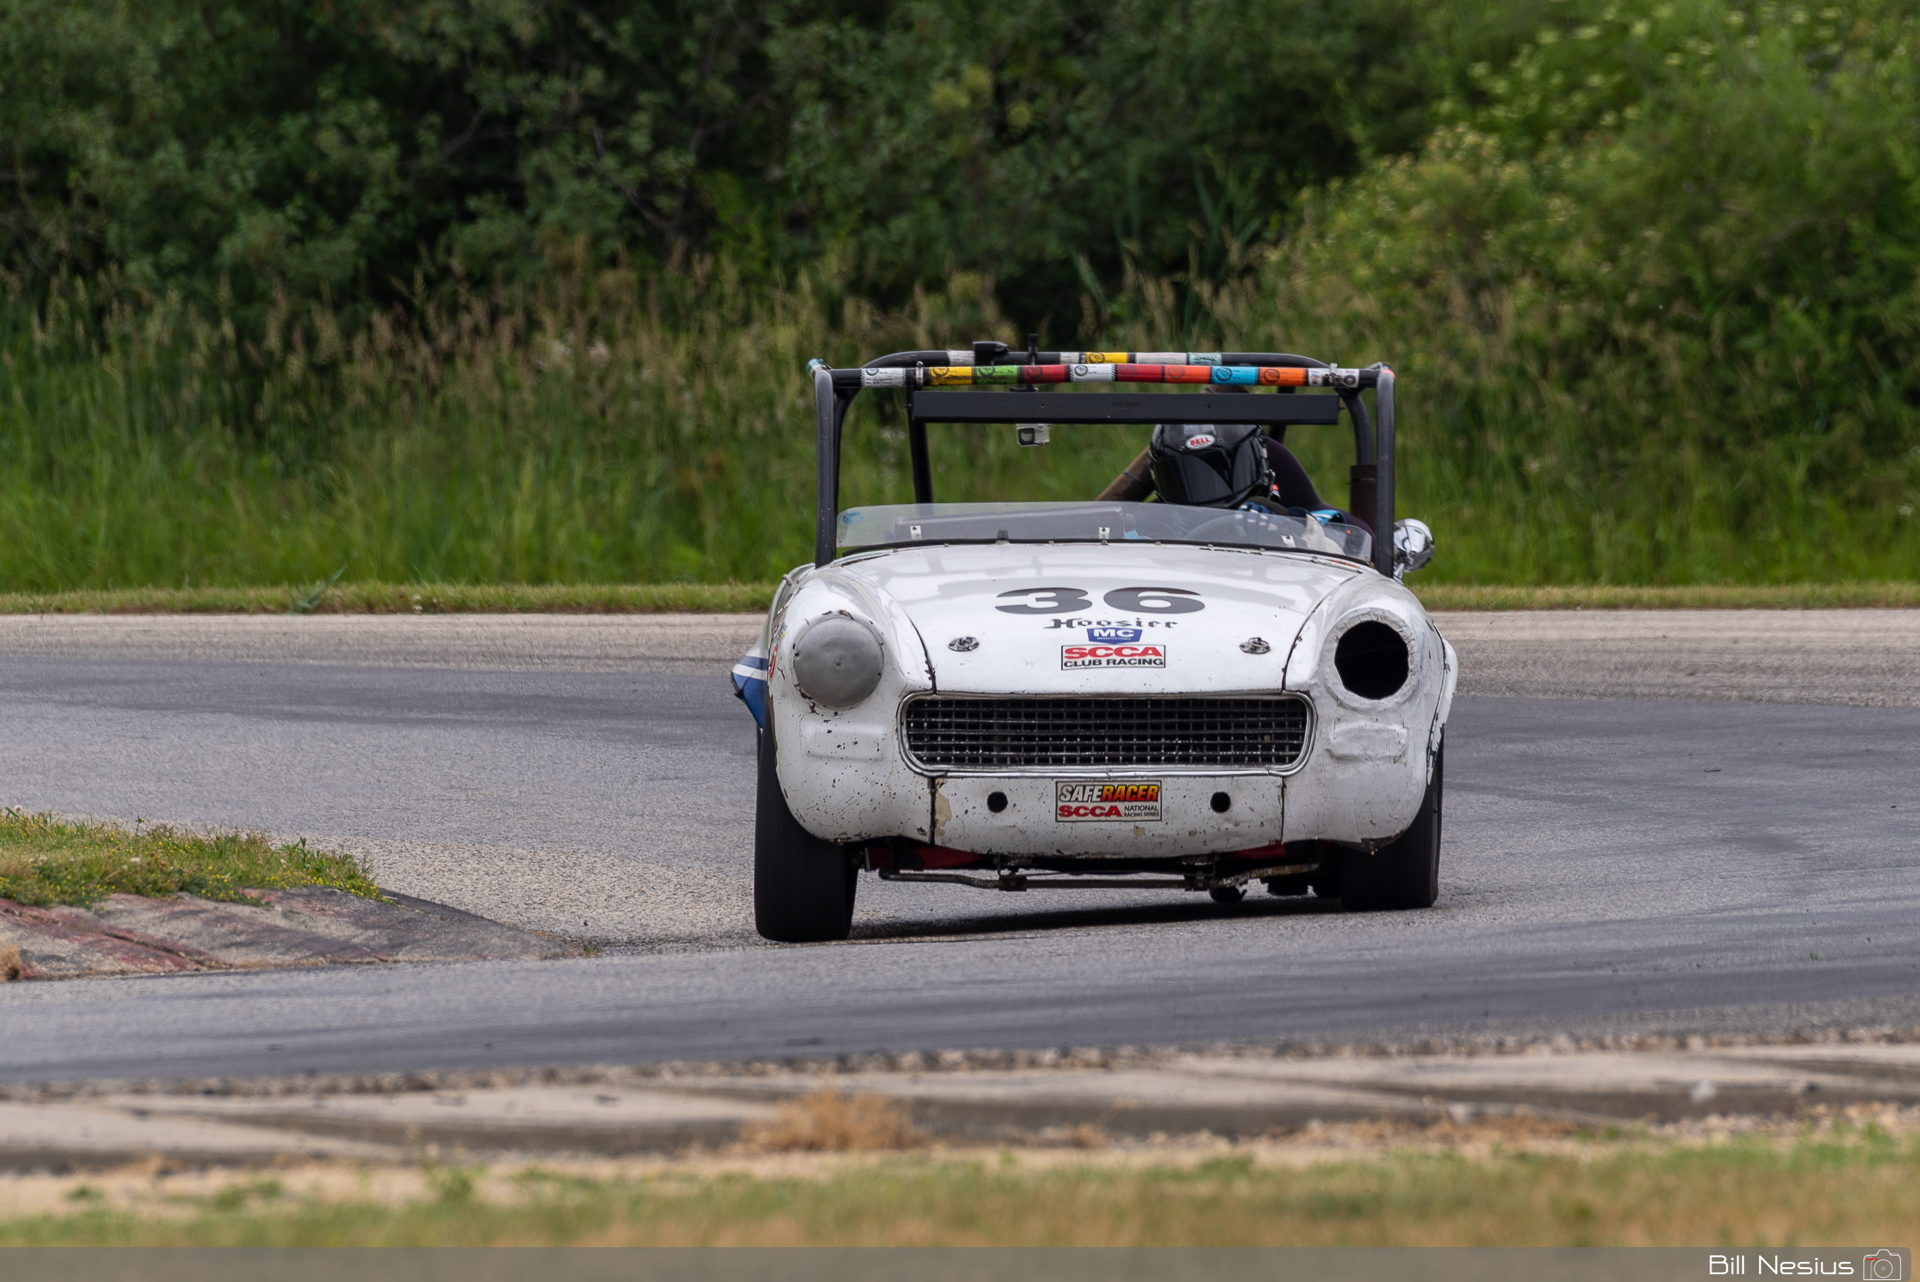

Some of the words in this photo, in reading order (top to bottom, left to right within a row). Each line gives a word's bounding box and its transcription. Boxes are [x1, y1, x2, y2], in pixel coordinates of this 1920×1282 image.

[1190, 437, 1210, 446] BELL
[995, 587, 1205, 614] 36
[1043, 617, 1178, 629] Hoosier
[1093, 628, 1135, 637] MC
[1064, 646, 1162, 659] SCCA
[1063, 658, 1102, 668] CLUB
[1106, 657, 1164, 667] RACING
[1058, 805, 1122, 817] SCCA
